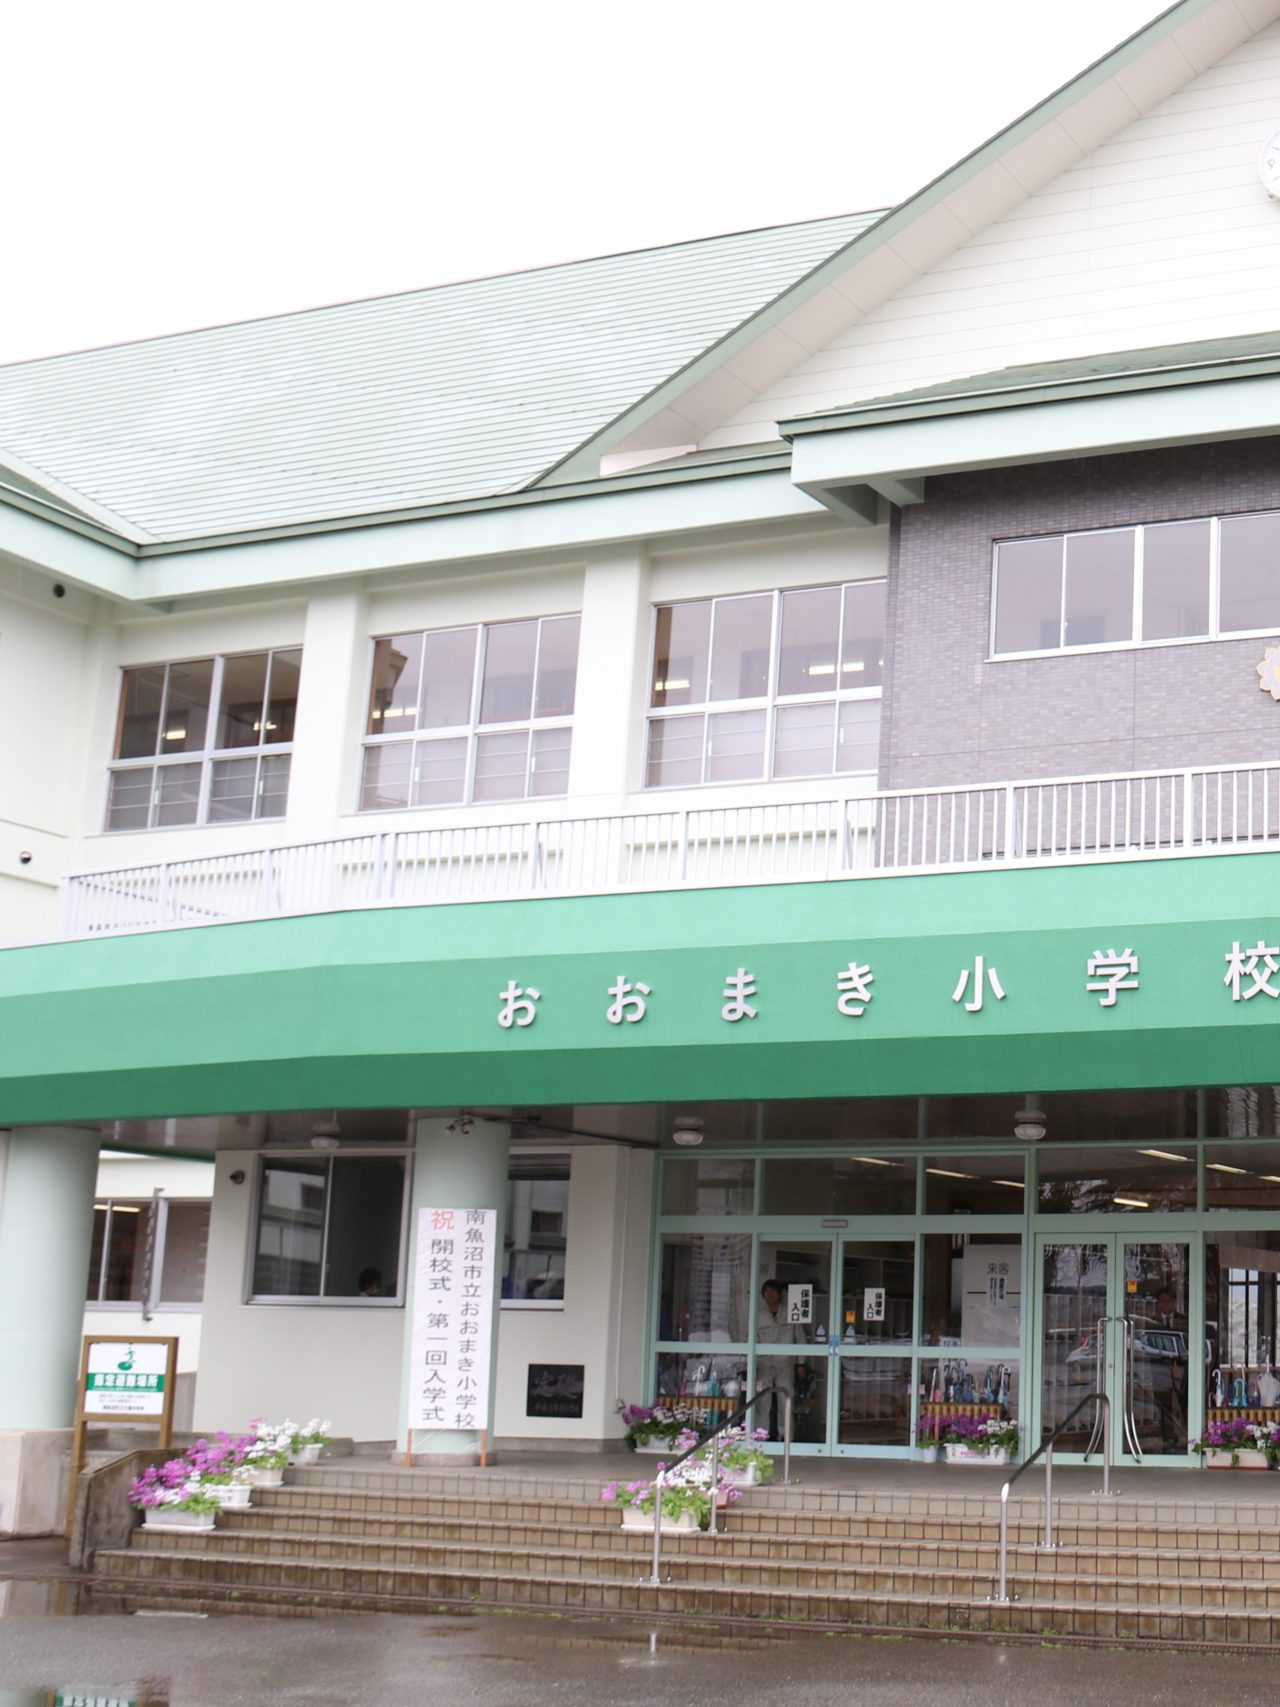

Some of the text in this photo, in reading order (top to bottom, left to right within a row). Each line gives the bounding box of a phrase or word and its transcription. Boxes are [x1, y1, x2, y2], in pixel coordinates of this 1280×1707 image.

[1267, 158, 1276, 170] 9
[431, 1210, 455, 1230] 祝
[455, 1209, 486, 1428] 南魚沼市立おおまき小学校
[791, 1302, 800, 1322] 入口
[867, 1303, 874, 1319] 入口
